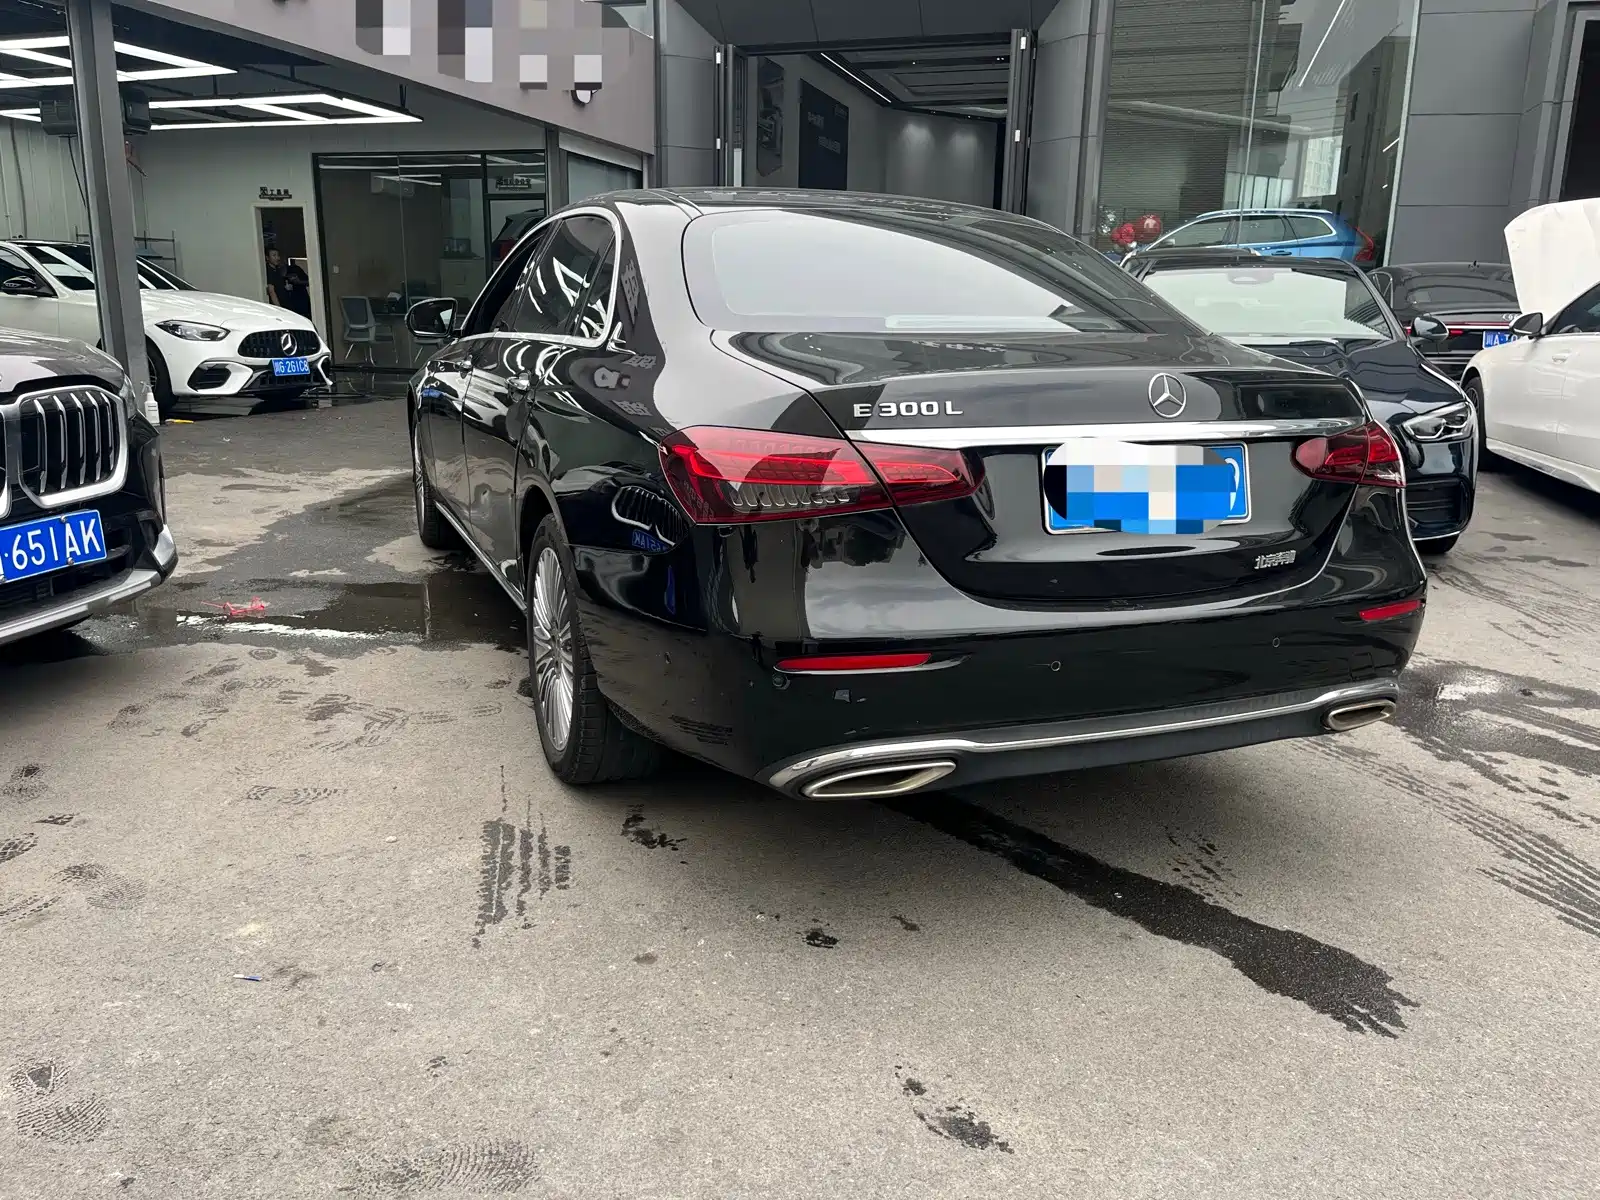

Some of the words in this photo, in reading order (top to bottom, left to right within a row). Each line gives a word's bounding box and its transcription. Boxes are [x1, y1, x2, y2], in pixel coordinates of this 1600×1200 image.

[853, 403, 873, 418] E
[879, 401, 939, 417] 300
[945, 400, 964, 415] L
